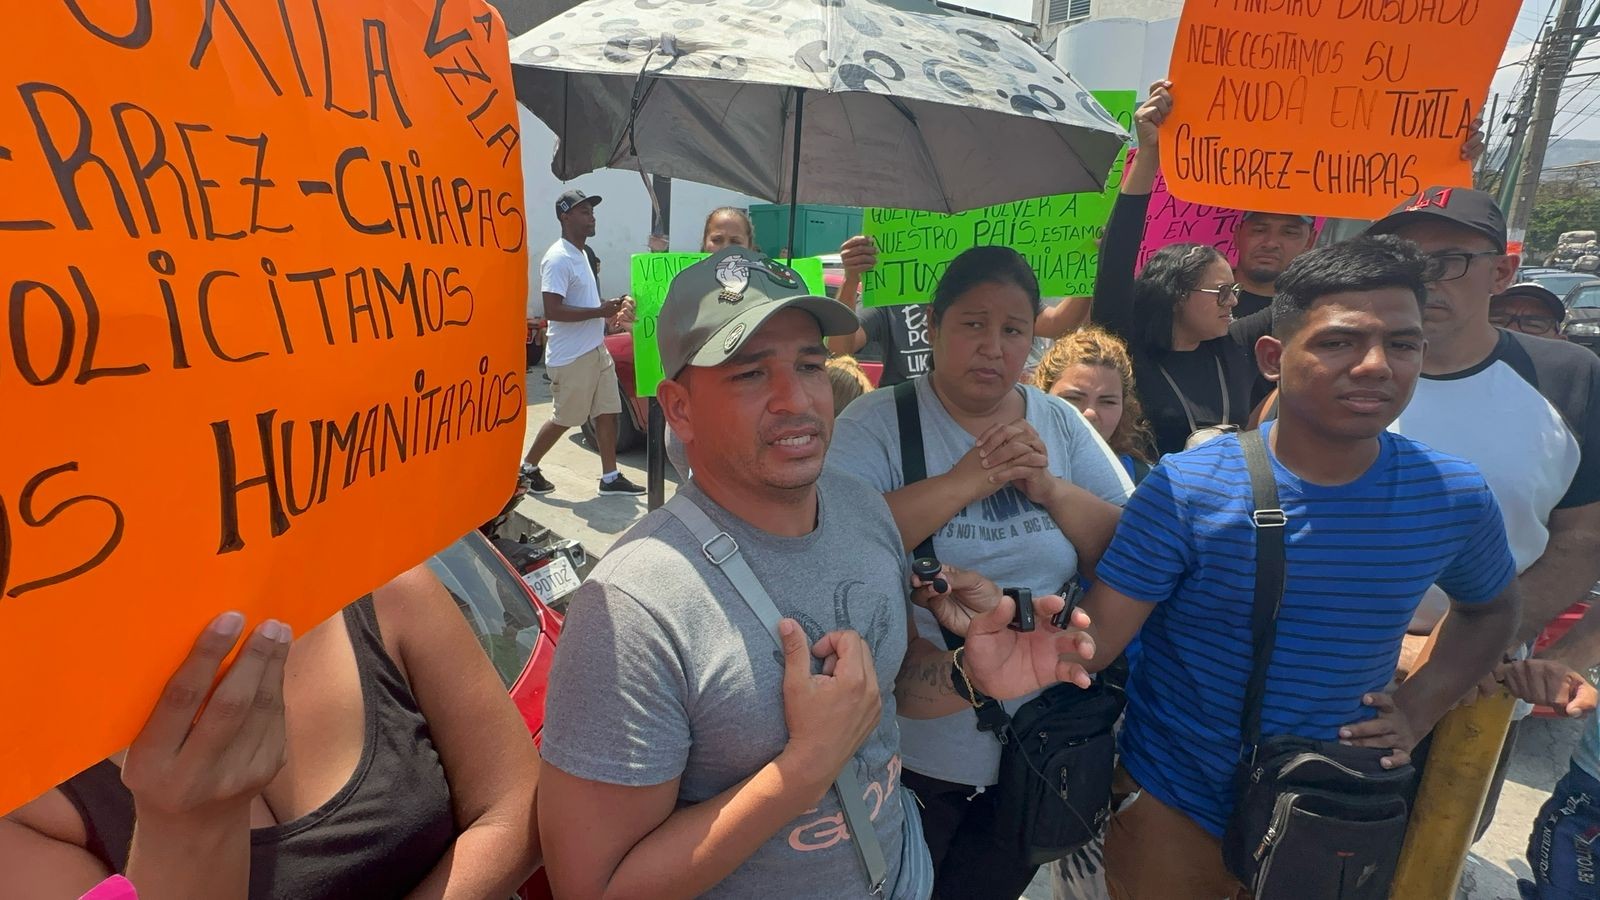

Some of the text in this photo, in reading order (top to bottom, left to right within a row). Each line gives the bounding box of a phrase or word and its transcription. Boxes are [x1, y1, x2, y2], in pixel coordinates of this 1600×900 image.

[1361, 40, 1411, 82] SU
[1206, 74, 1472, 143] AYUDA EN TUXTLA
[1059, 193, 1078, 218] A
[871, 225, 958, 254] NUESTRO
[1162, 219, 1200, 240] EN
[639, 256, 703, 283] VEN
[864, 267, 886, 293] EN
[0, 461, 125, 598] S
[957, 523, 976, 540] NOT
[979, 525, 1008, 542] MAKE
[1010, 524, 1020, 539] A
